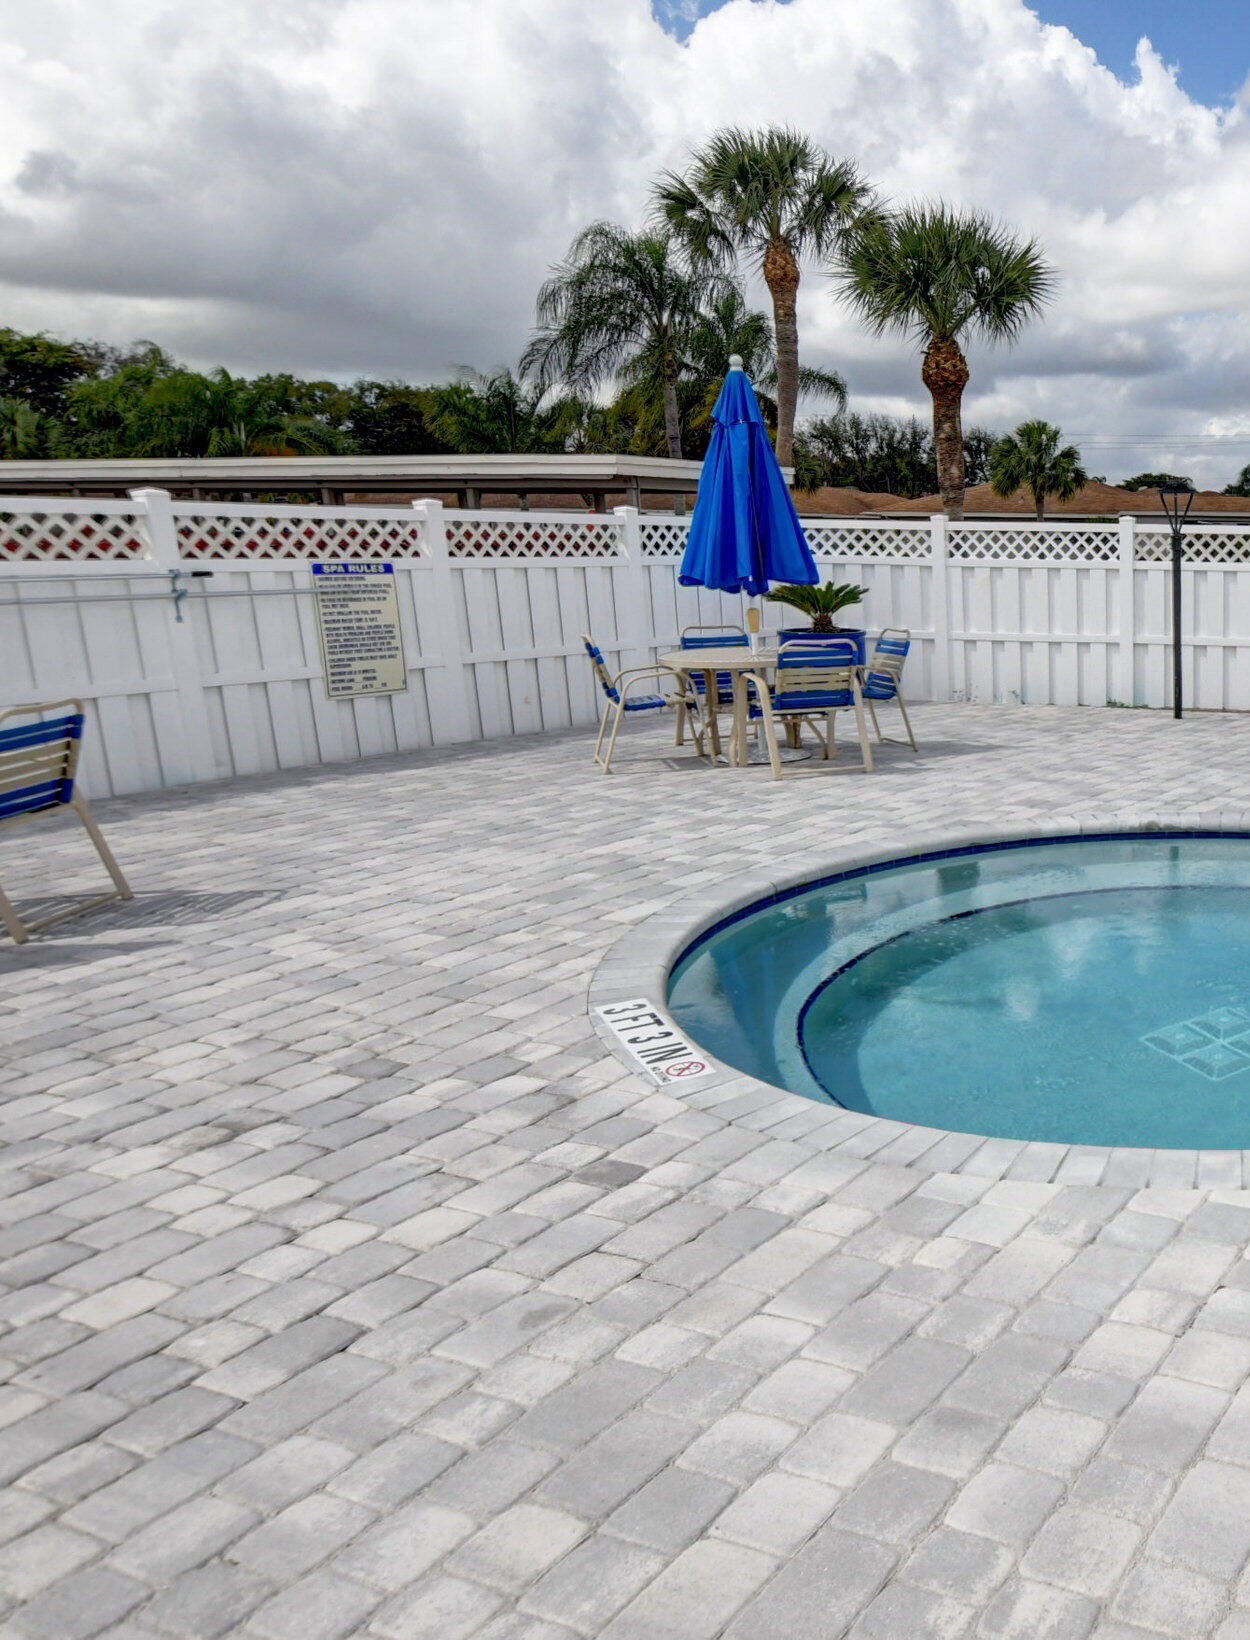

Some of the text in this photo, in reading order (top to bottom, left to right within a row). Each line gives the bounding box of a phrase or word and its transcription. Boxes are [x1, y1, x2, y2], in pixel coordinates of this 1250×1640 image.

[322, 564, 385, 573] SPA RULES
[603, 1003, 647, 1015] 3
[610, 1012, 665, 1032] FT
[627, 1031, 674, 1044] 3
[636, 1042, 693, 1065] IN
